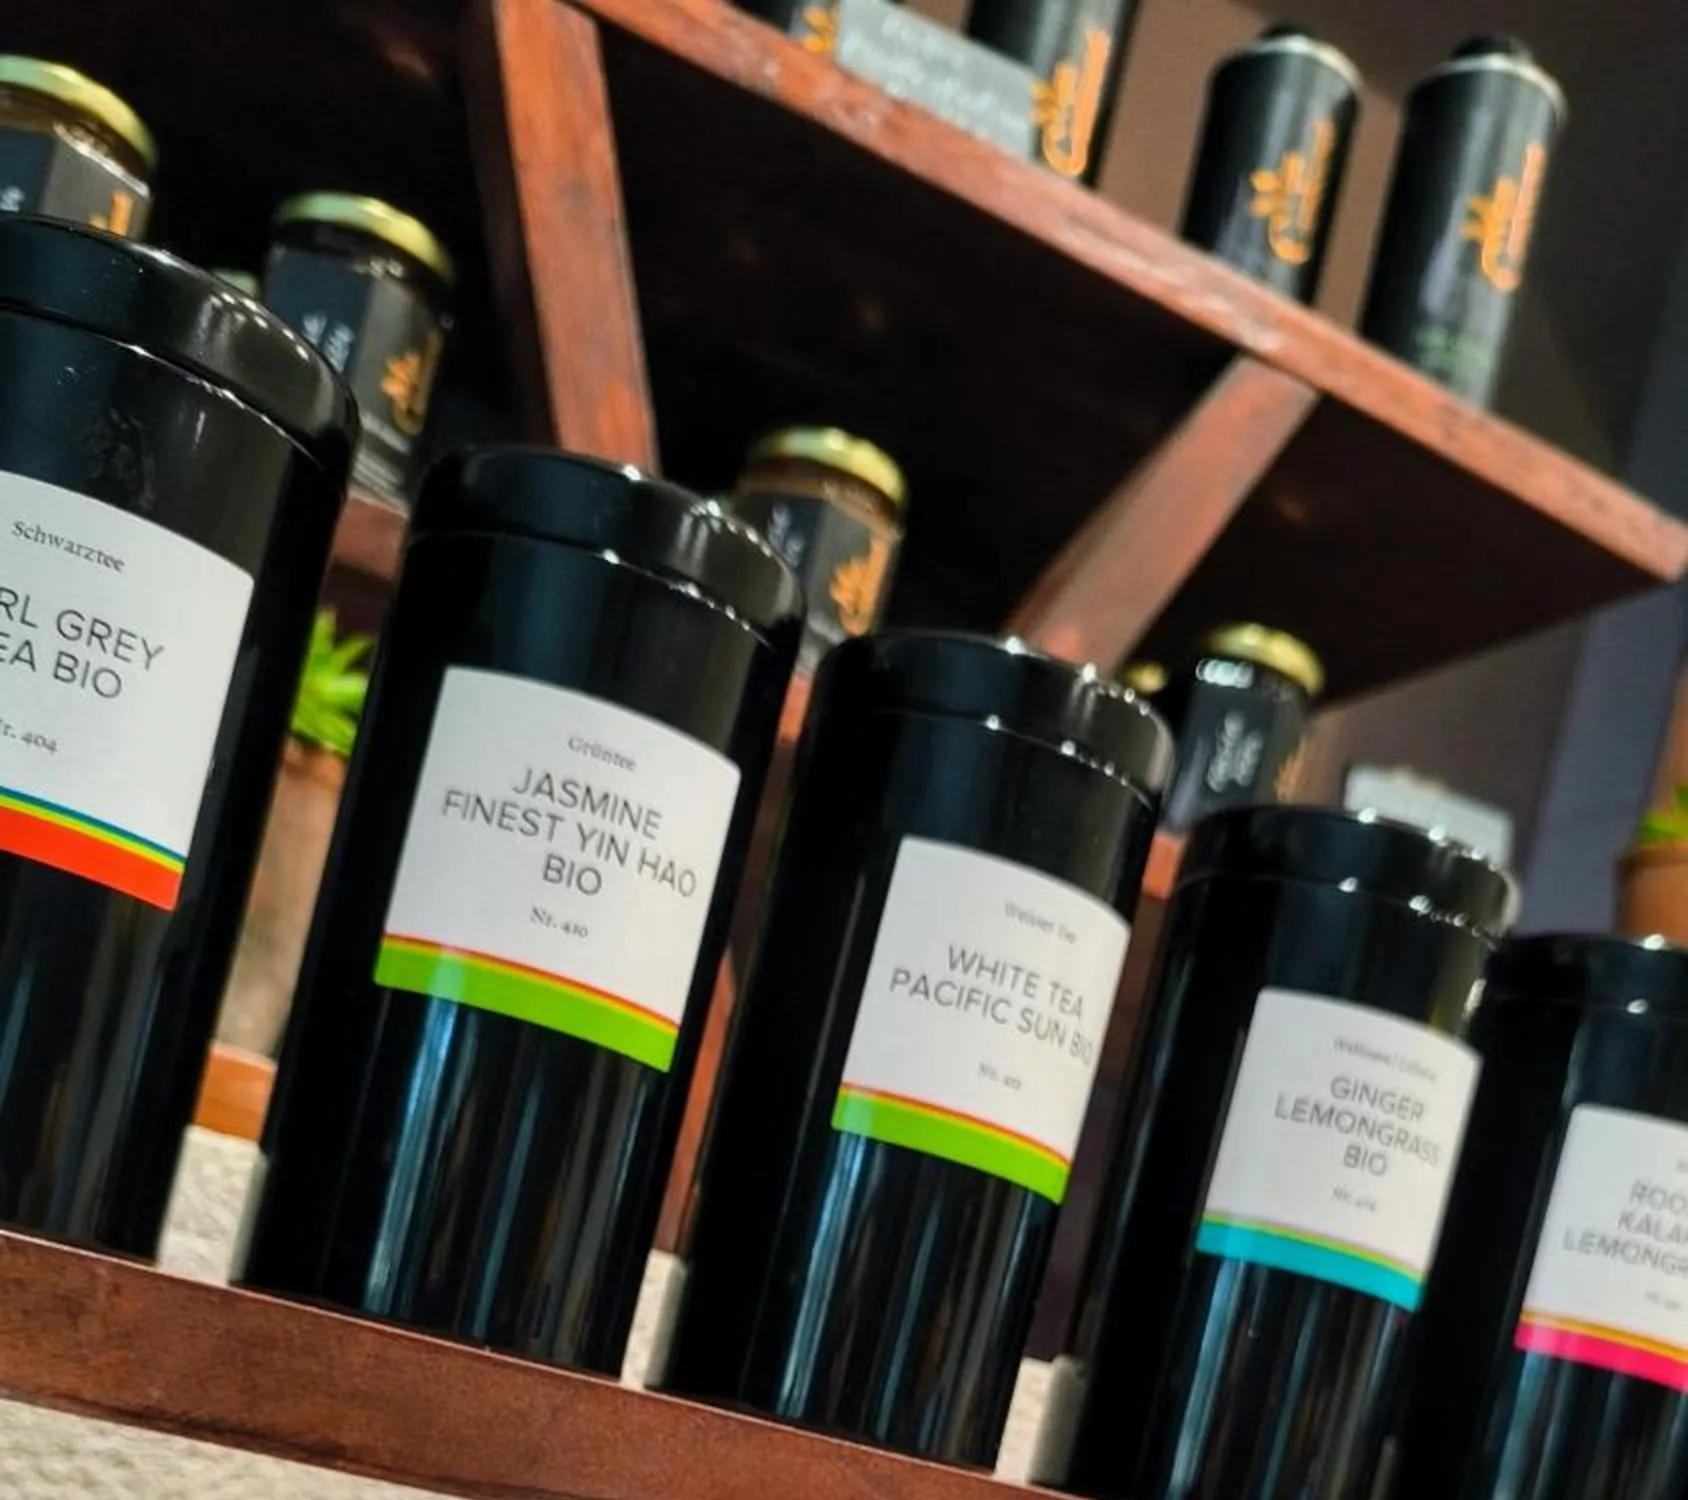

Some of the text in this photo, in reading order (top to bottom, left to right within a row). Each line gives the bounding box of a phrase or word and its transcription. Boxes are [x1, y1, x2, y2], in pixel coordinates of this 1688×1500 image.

[12, 520, 125, 573] Schwarztee
[56, 609, 165, 671] GREY
[53, 650, 122, 699] BIO
[512, 766, 663, 840] JASMINE
[442, 789, 698, 897] FINEST YIN HAO
[543, 853, 602, 897] BIO
[530, 904, 557, 928] Nr.
[889, 967, 1012, 1025] PACIFIC
[1016, 1008, 1067, 1050] SUN
[948, 945, 1084, 1020] WHITE TEA
[1330, 1076, 1425, 1123] GINGER
[1274, 1092, 1441, 1168] LEMONGRASS
[1343, 1144, 1388, 1177] BIO
